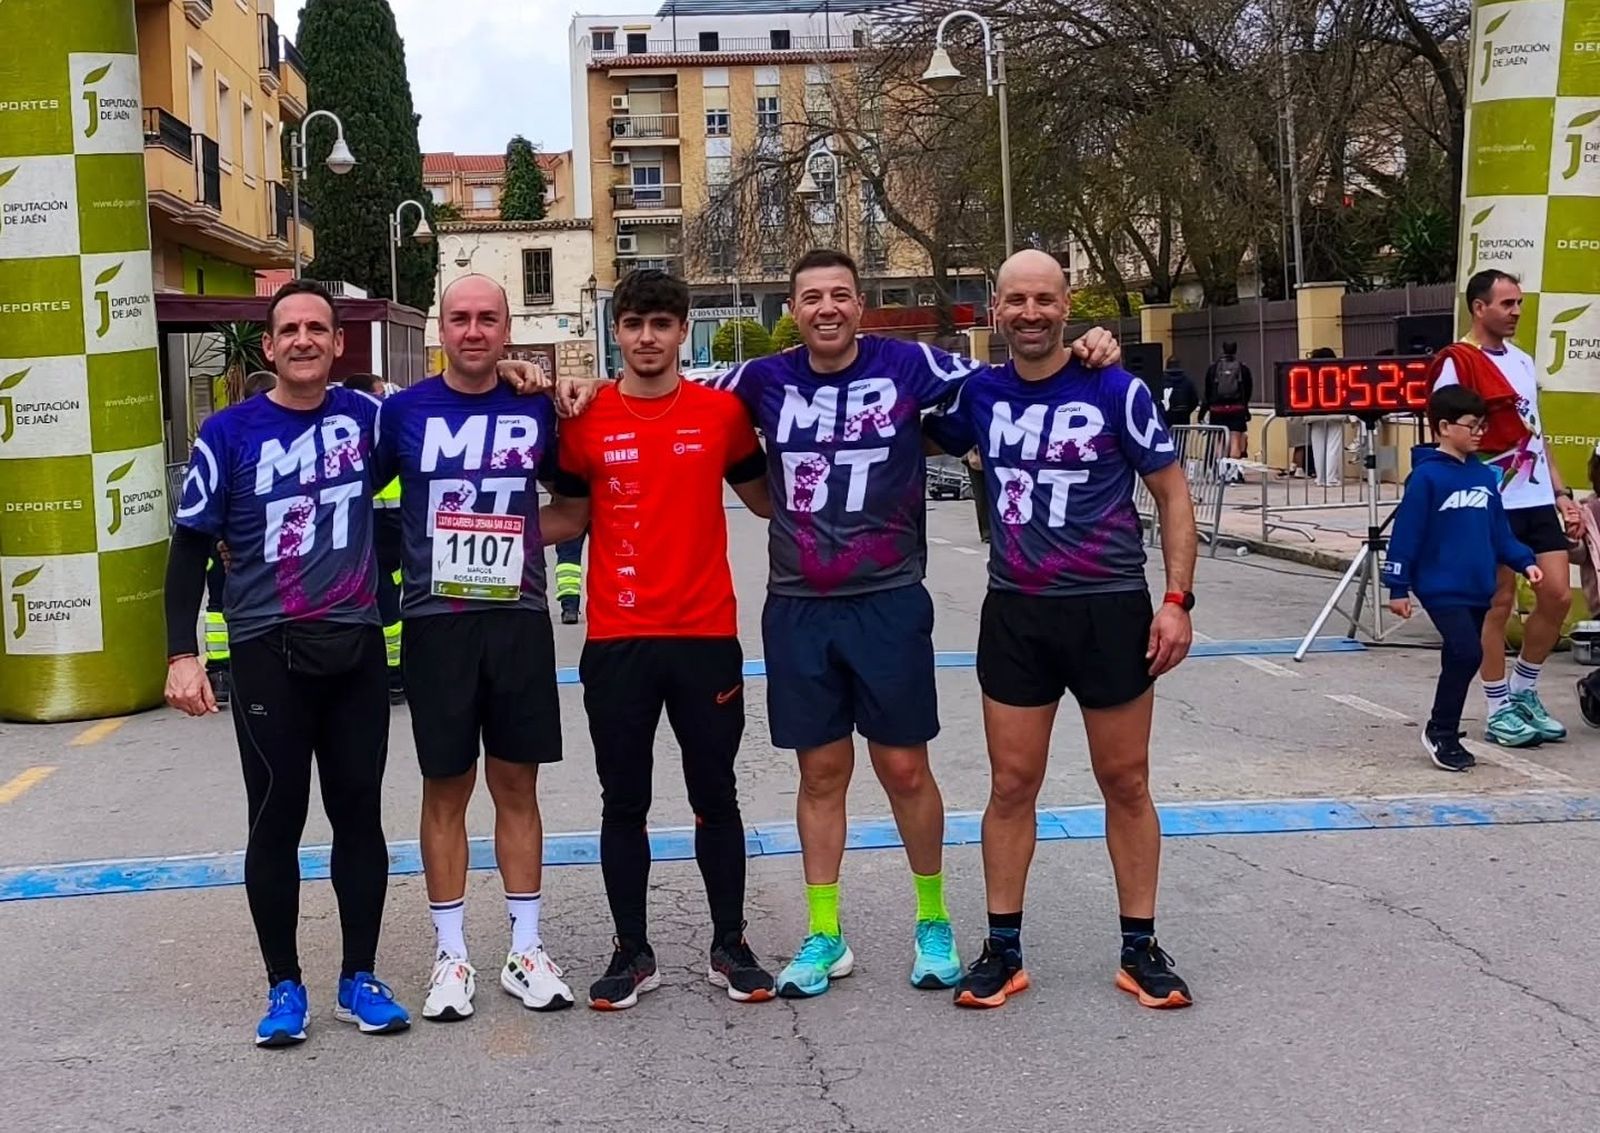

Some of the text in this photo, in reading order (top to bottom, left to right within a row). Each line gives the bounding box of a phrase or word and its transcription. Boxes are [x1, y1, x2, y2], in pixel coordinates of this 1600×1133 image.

[1494, 43, 1550, 56] DIPUTACIÓN
[101, 111, 112, 120] DE
[3, 200, 68, 213] DIPUTACIÓN
[4, 213, 47, 225] DE JAÉN
[1479, 238, 1534, 248] DIPUTACIÓN
[0, 300, 71, 313] EPORTES
[112, 310, 124, 320] DE
[1569, 350, 1583, 359] DE
[16, 400, 80, 413] DIPUTACIÓN
[776, 378, 898, 443] MR
[16, 414, 59, 425] DE JAÉN
[988, 401, 1106, 462] MR
[420, 415, 539, 472] MR
[254, 414, 364, 496] MR
[781, 447, 890, 512] BT
[6, 500, 82, 512] DEPORTES
[124, 506, 136, 516] DE
[447, 533, 514, 567] 1107
[454, 575, 506, 584] ROSA FUENTES
[28, 598, 91, 610] DIPUTACIÓN
[29, 611, 70, 622] DE JAÉN
